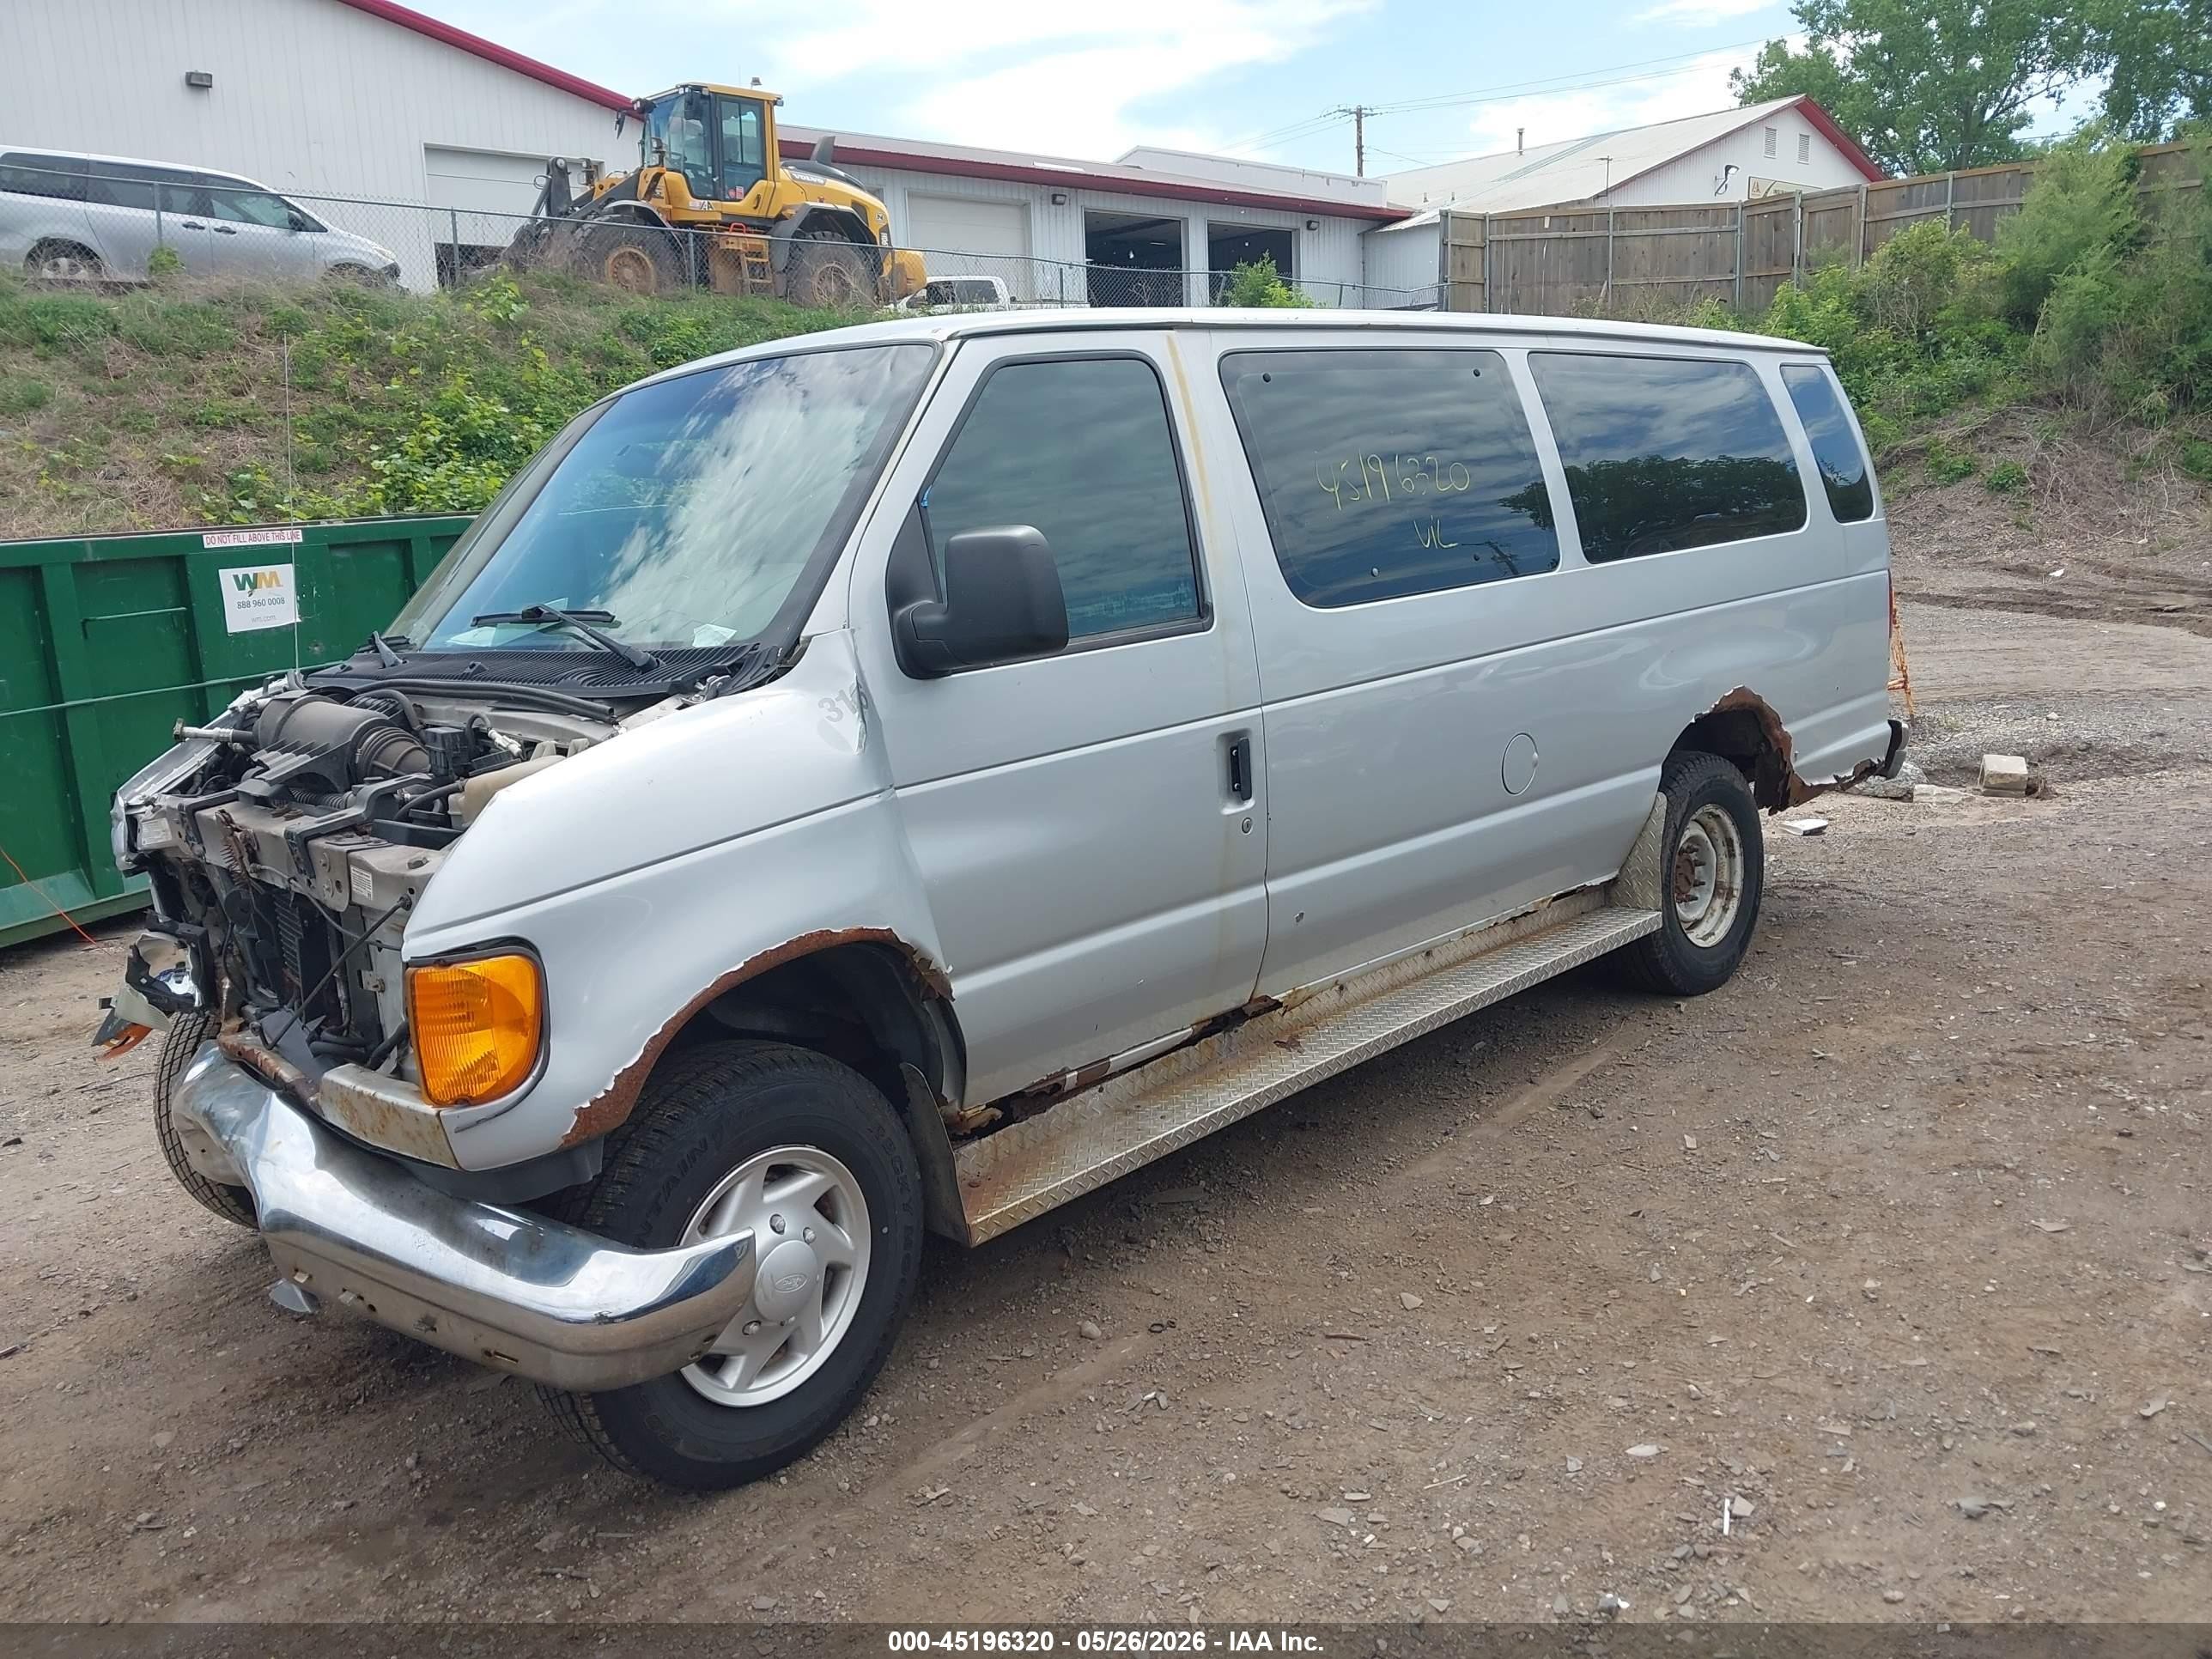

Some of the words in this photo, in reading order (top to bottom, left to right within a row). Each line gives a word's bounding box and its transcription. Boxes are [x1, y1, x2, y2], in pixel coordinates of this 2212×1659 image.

[206, 536, 216, 544] DO
[218, 535, 230, 544] NOT
[234, 534, 246, 543] FILL
[248, 533, 270, 542] ABOVE
[287, 531, 301, 540] LINE
[233, 570, 281, 591] WM
[237, 601, 251, 610] 888
[252, 599, 266, 607] 960
[268, 597, 285, 605] 0008
